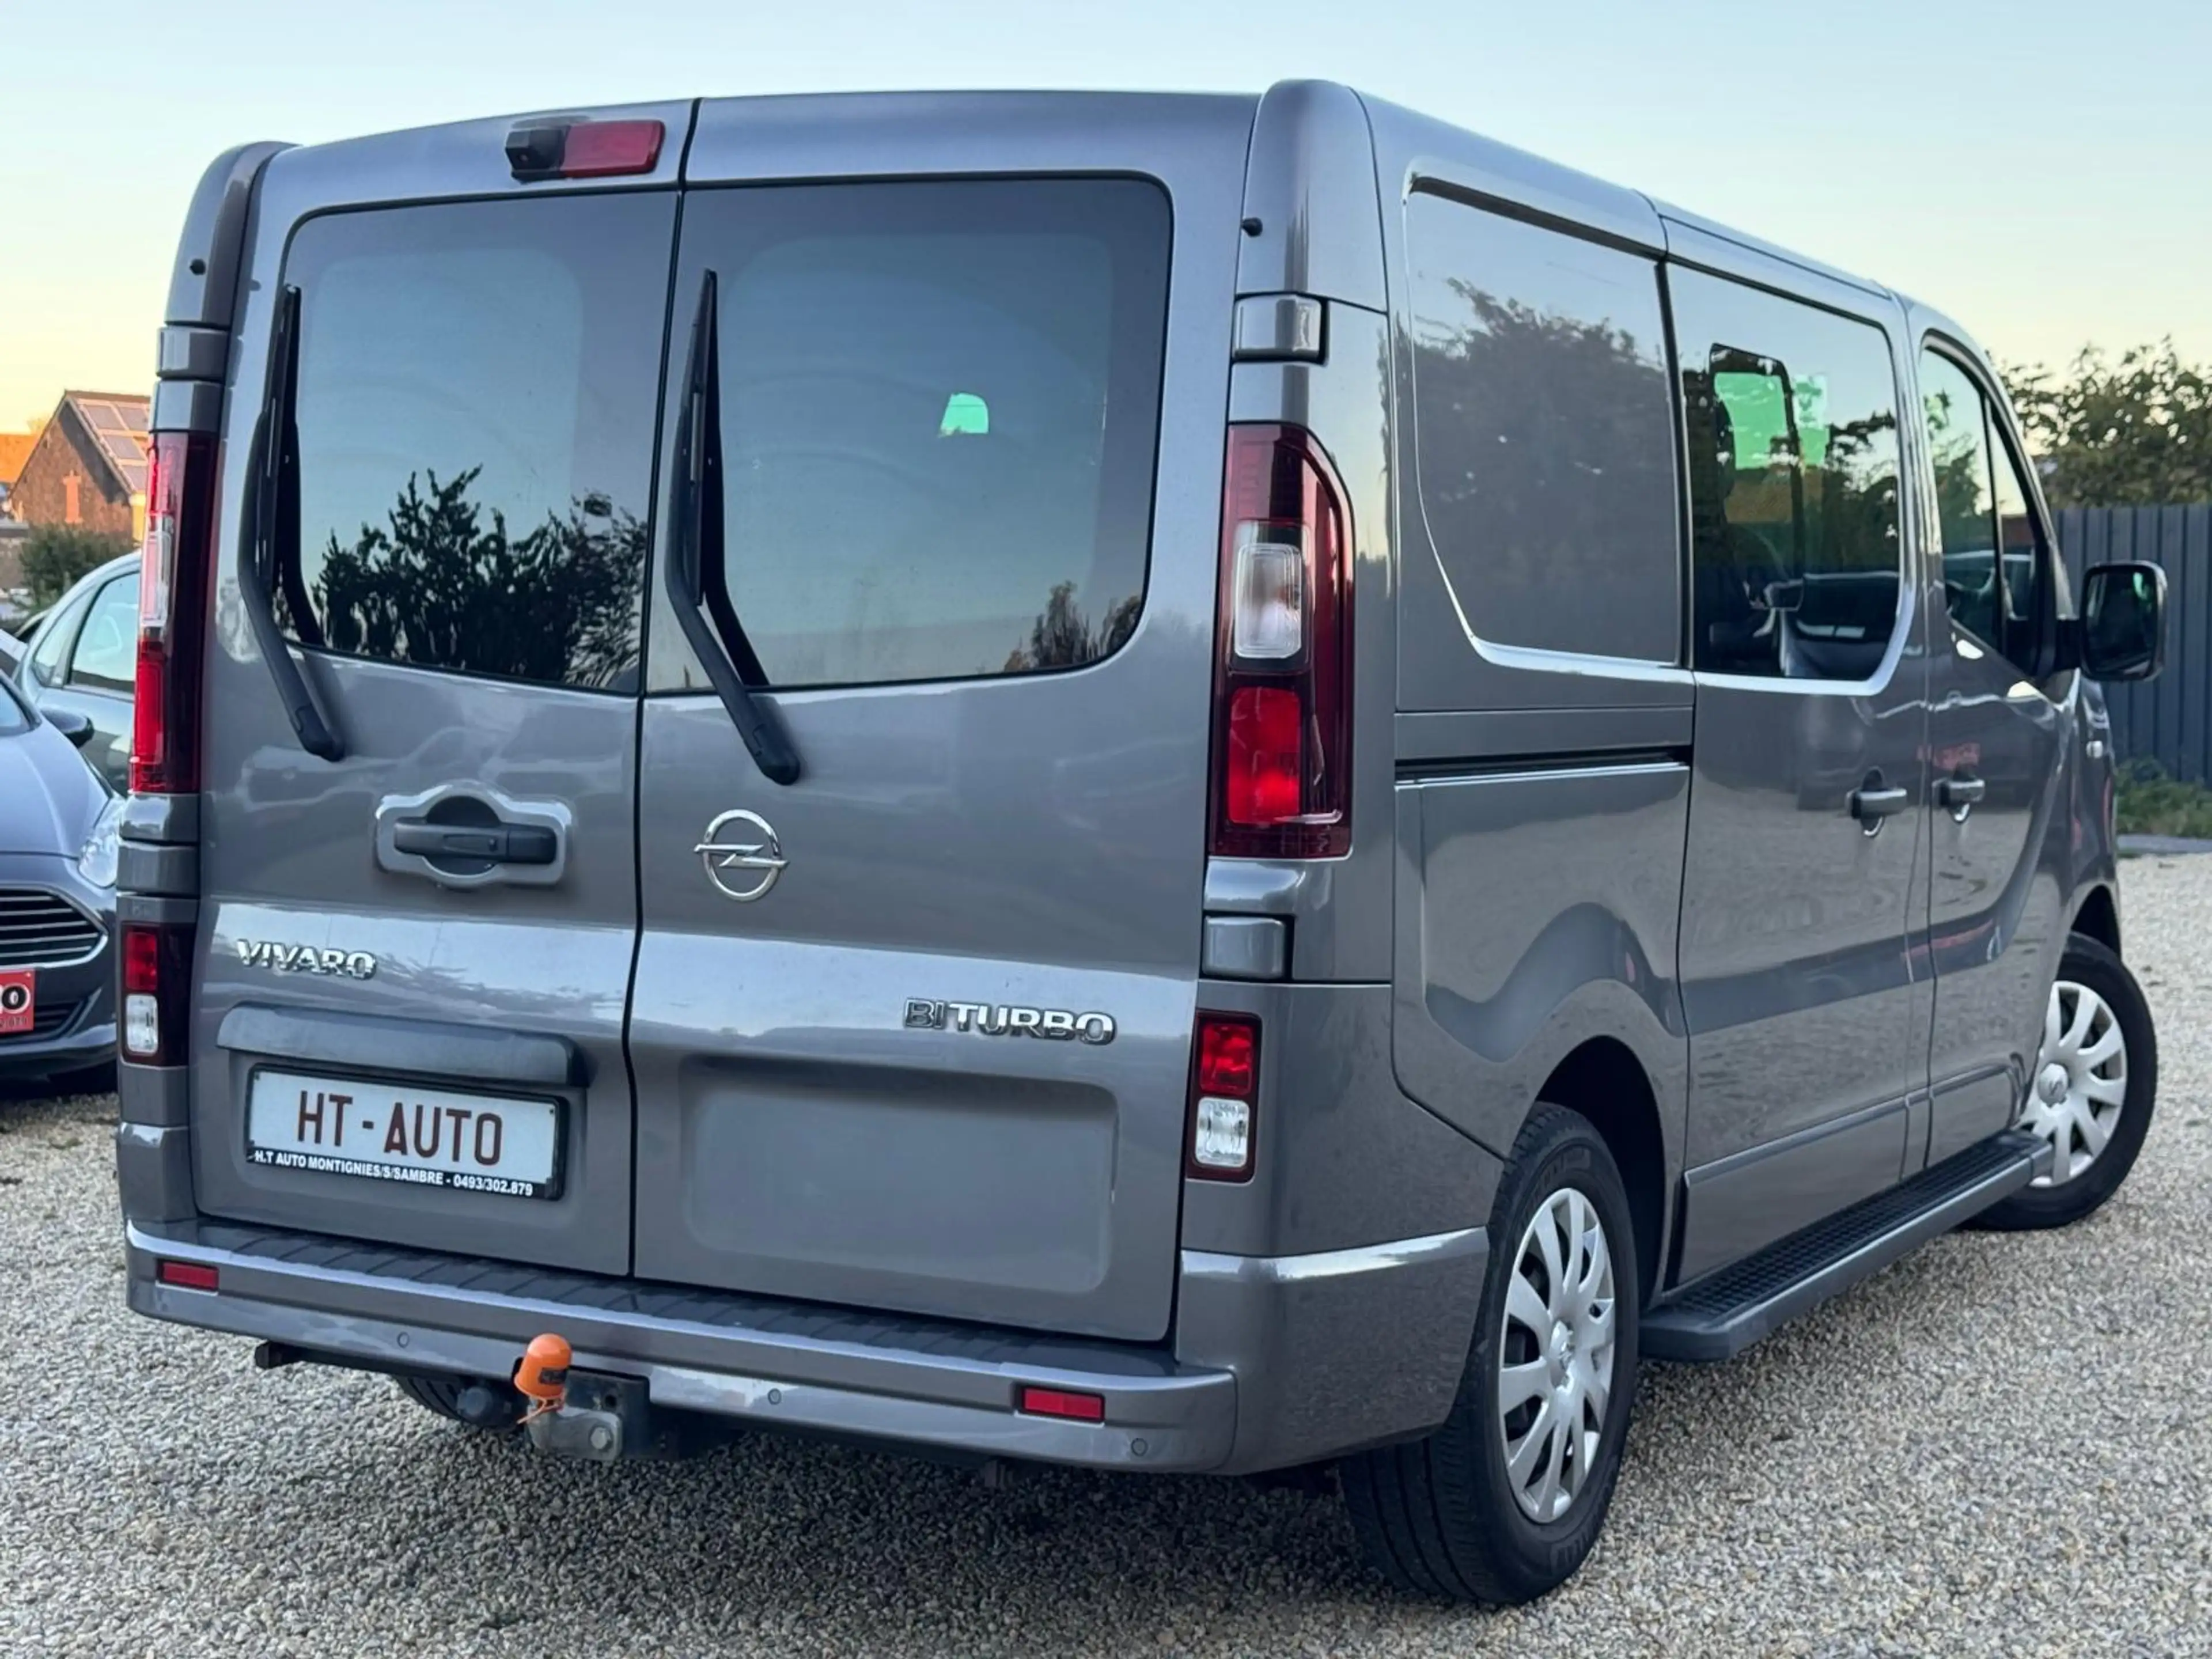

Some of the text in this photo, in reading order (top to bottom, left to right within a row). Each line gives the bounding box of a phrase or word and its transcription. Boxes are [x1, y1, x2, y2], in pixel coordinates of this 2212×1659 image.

[237, 938, 377, 979] VIVARO
[297, 1090, 353, 1146] HT
[384, 1102, 503, 1166] AUTO
[255, 1150, 274, 1163] H.T
[276, 1152, 306, 1168] AUTO
[308, 1156, 444, 1185] MONTIGNIES/S/SAMBRE
[453, 1174, 533, 1196] 0493/302.879
